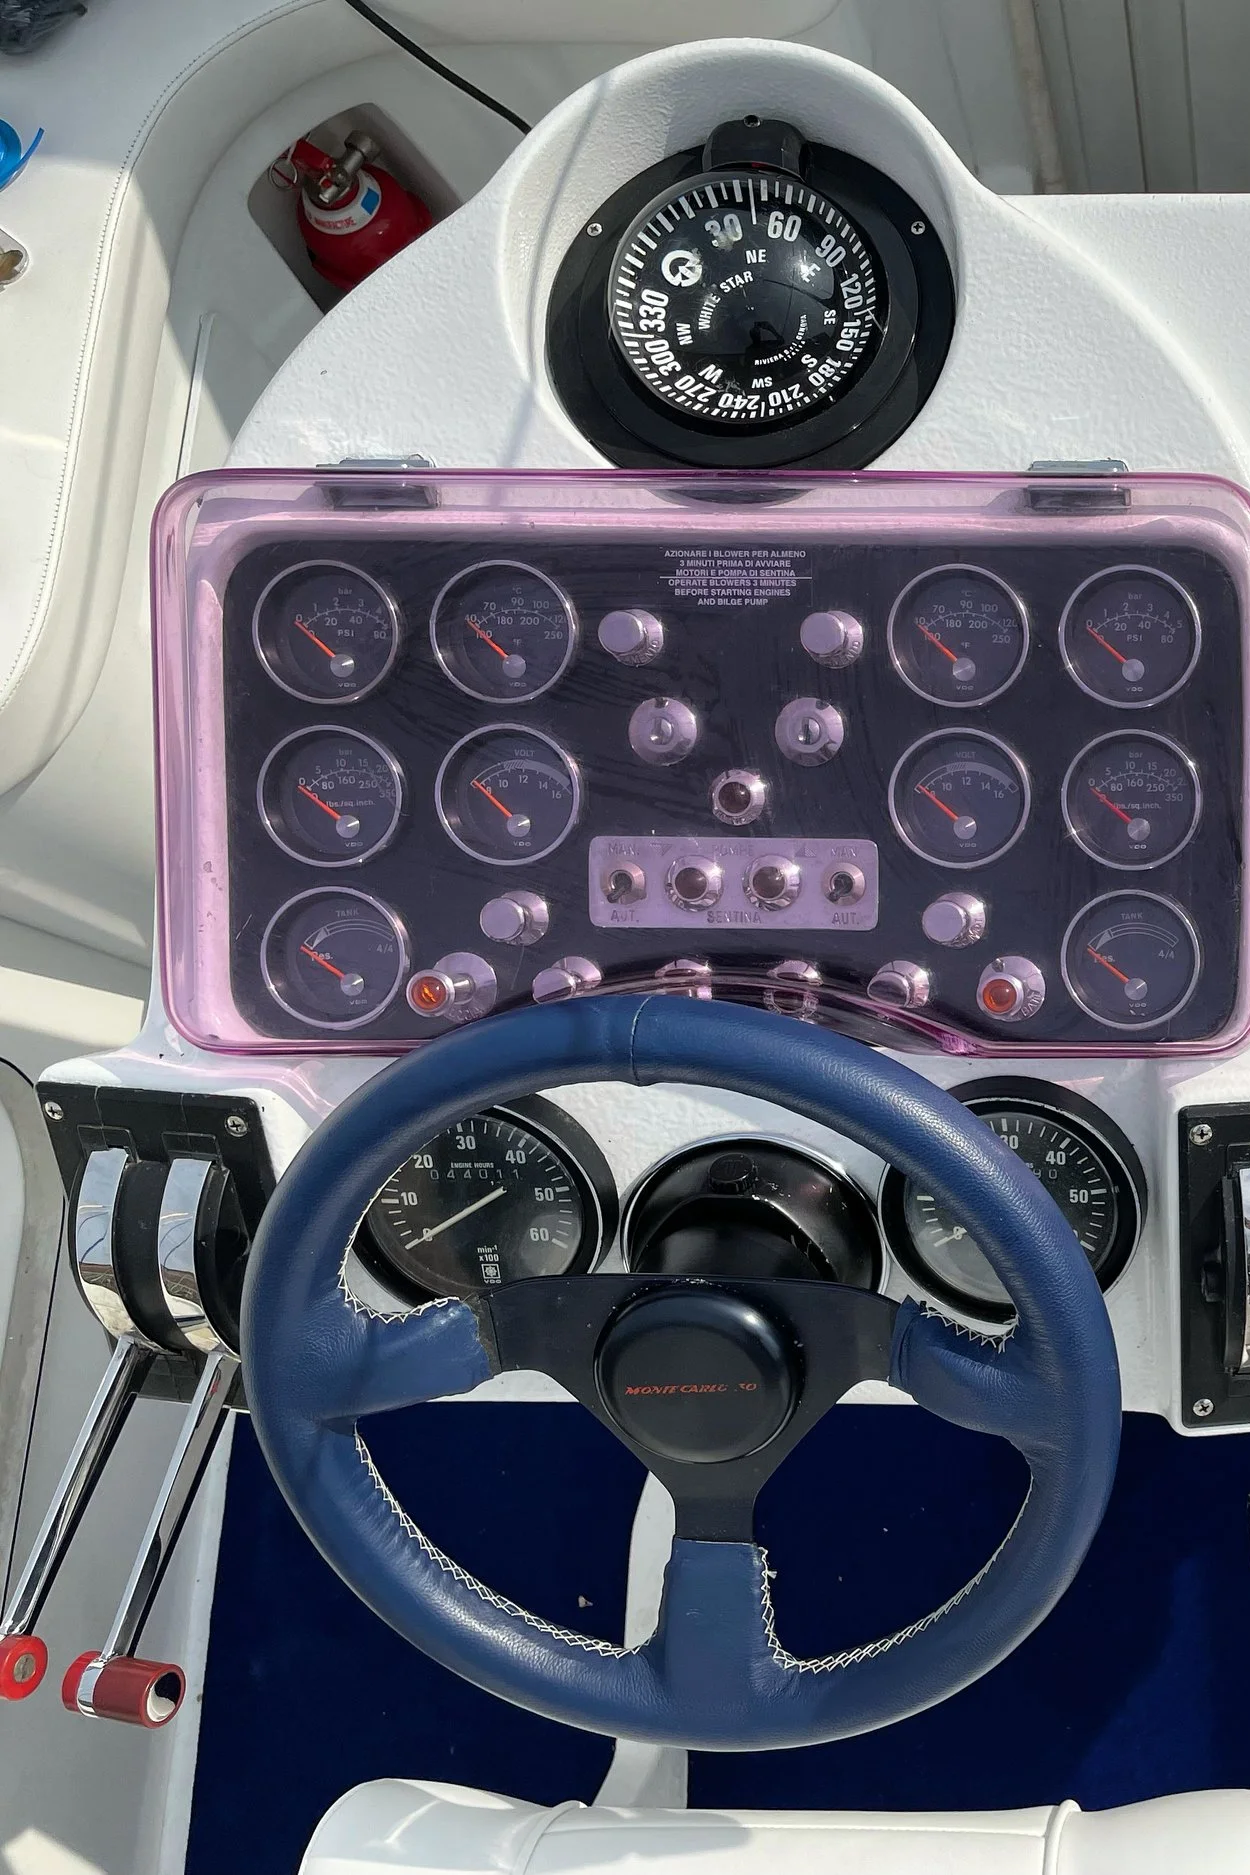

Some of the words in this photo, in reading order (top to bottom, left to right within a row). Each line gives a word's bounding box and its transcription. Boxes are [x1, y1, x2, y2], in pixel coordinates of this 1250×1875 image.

[767, 211, 801, 242] 60
[815, 234, 846, 268] 90
[745, 249, 767, 264] NE
[840, 273, 863, 310] 120
[698, 293, 721, 330] WHITE
[719, 270, 753, 293] STAR
[639, 289, 669, 333] 330
[823, 309, 837, 326] SE
[676, 322, 693, 346] NW
[836, 319, 861, 352] 150
[644, 339, 682, 376] 300
[754, 353, 784, 366] RIVIERA
[801, 354, 818, 368] S
[698, 364, 723, 384] W
[808, 355, 842, 387] 180
[751, 376, 773, 389] SW
[674, 375, 717, 403] 270
[768, 383, 804, 407] 210
[718, 392, 761, 410] 240
[665, 550, 706, 558] AZIONARE
[709, 550, 711, 558] I
[714, 550, 750, 558] BLOWER
[752, 550, 768, 558] PER
[771, 550, 806, 558] ALMENO
[332, 597, 339, 606] 2
[358, 599, 364, 607] 3
[511, 597, 524, 606] 90
[533, 601, 549, 609] 100
[960, 601, 973, 609] 90
[483, 602, 496, 611] 70
[932, 605, 945, 613] 70
[981, 604, 998, 612] 100
[1122, 603, 1129, 611] 2
[1147, 604, 1153, 612] 3
[1164, 611, 1170, 619] 4
[325, 617, 337, 626] 20
[349, 616, 362, 624] 40
[497, 616, 513, 625] 180
[520, 617, 539, 625] 200
[945, 619, 961, 628] 180
[969, 620, 988, 629] 200
[1086, 620, 1093, 628] 0
[1114, 623, 1127, 631] 20
[1138, 621, 1151, 629] 40
[337, 629, 354, 637] PSI
[544, 631, 563, 640] 250
[992, 635, 1010, 643] 250
[1127, 634, 1142, 642] PSI
[514, 749, 535, 757] VOLT
[335, 759, 346, 767] 10
[360, 759, 368, 767] 15
[1125, 761, 1135, 769] 10
[1148, 762, 1157, 770] 15
[316, 766, 321, 774] 5
[376, 764, 388, 772] 20
[1105, 767, 1111, 775] 5
[1163, 769, 1176, 777] 20
[299, 778, 305, 786] 0
[338, 776, 355, 784] 160
[519, 775, 528, 783] 12
[962, 777, 971, 785] 12
[1088, 778, 1095, 786] 0
[1127, 779, 1143, 787] 160
[321, 781, 334, 790] 80
[359, 780, 378, 789] 250
[499, 780, 508, 788] 10
[539, 781, 548, 790] 14
[942, 783, 952, 791] 10
[981, 782, 991, 790] 14
[1110, 783, 1123, 791] 80
[1146, 784, 1165, 792] 250
[552, 790, 561, 799] 16
[994, 790, 1004, 798] 16
[1165, 793, 1183, 801] 350
[335, 908, 360, 917] TANK
[610, 910, 640, 923] AUT.
[706, 910, 763, 924] SENTINA
[831, 912, 861, 925] AUT.
[1158, 950, 1174, 959] 4/4
[456, 1135, 476, 1150] 30
[413, 1154, 433, 1169] 20
[505, 1150, 526, 1164] 40
[1045, 1151, 1066, 1165] 40
[400, 1192, 418, 1206] 10
[534, 1187, 555, 1202] 50
[1069, 1189, 1089, 1204] 50
[529, 1227, 550, 1242] 60
[479, 1254, 499, 1262] x100
[625, 1385, 679, 1395] MONTE
